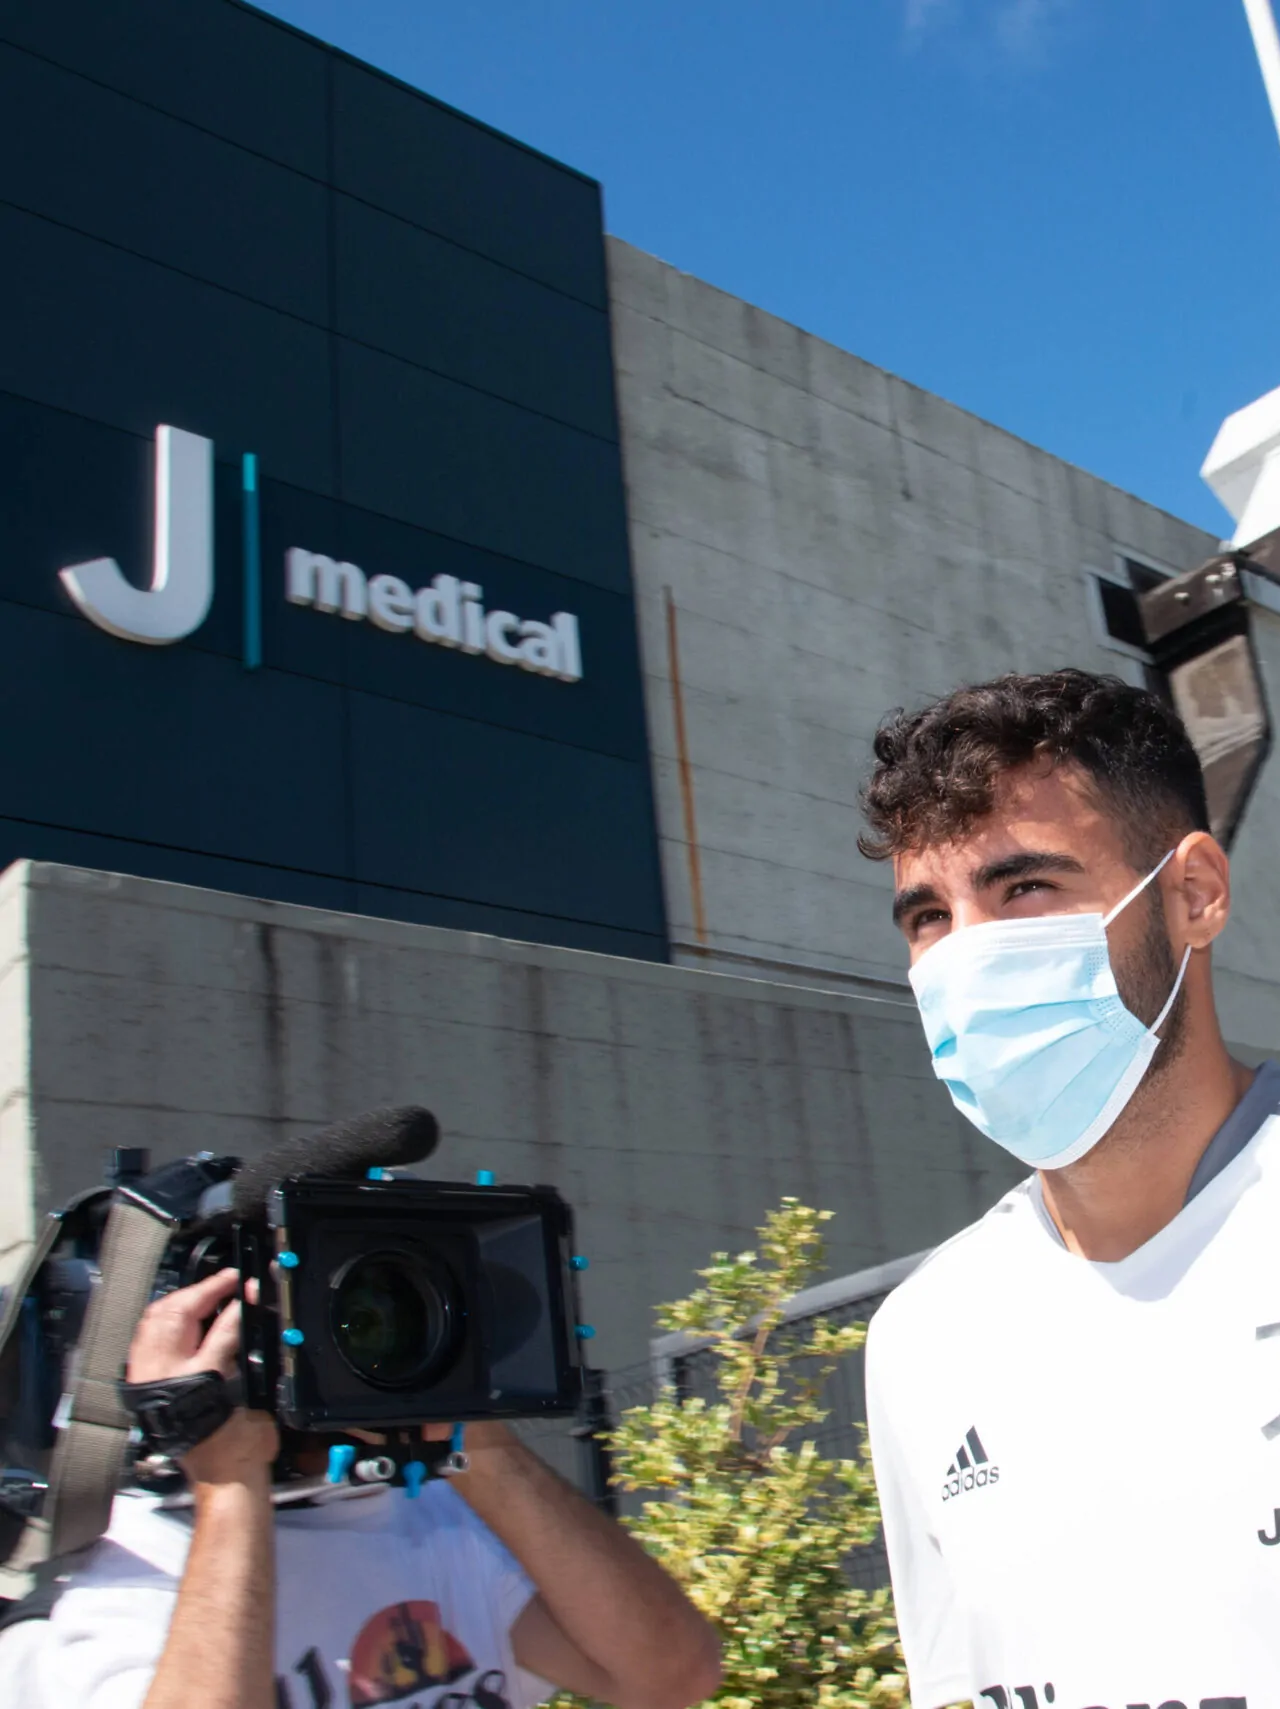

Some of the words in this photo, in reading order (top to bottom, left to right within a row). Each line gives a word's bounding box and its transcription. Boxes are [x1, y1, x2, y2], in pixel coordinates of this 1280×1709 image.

[58, 423, 214, 646] J
[285, 546, 583, 683] medical
[941, 1465, 1000, 1502] adidas
